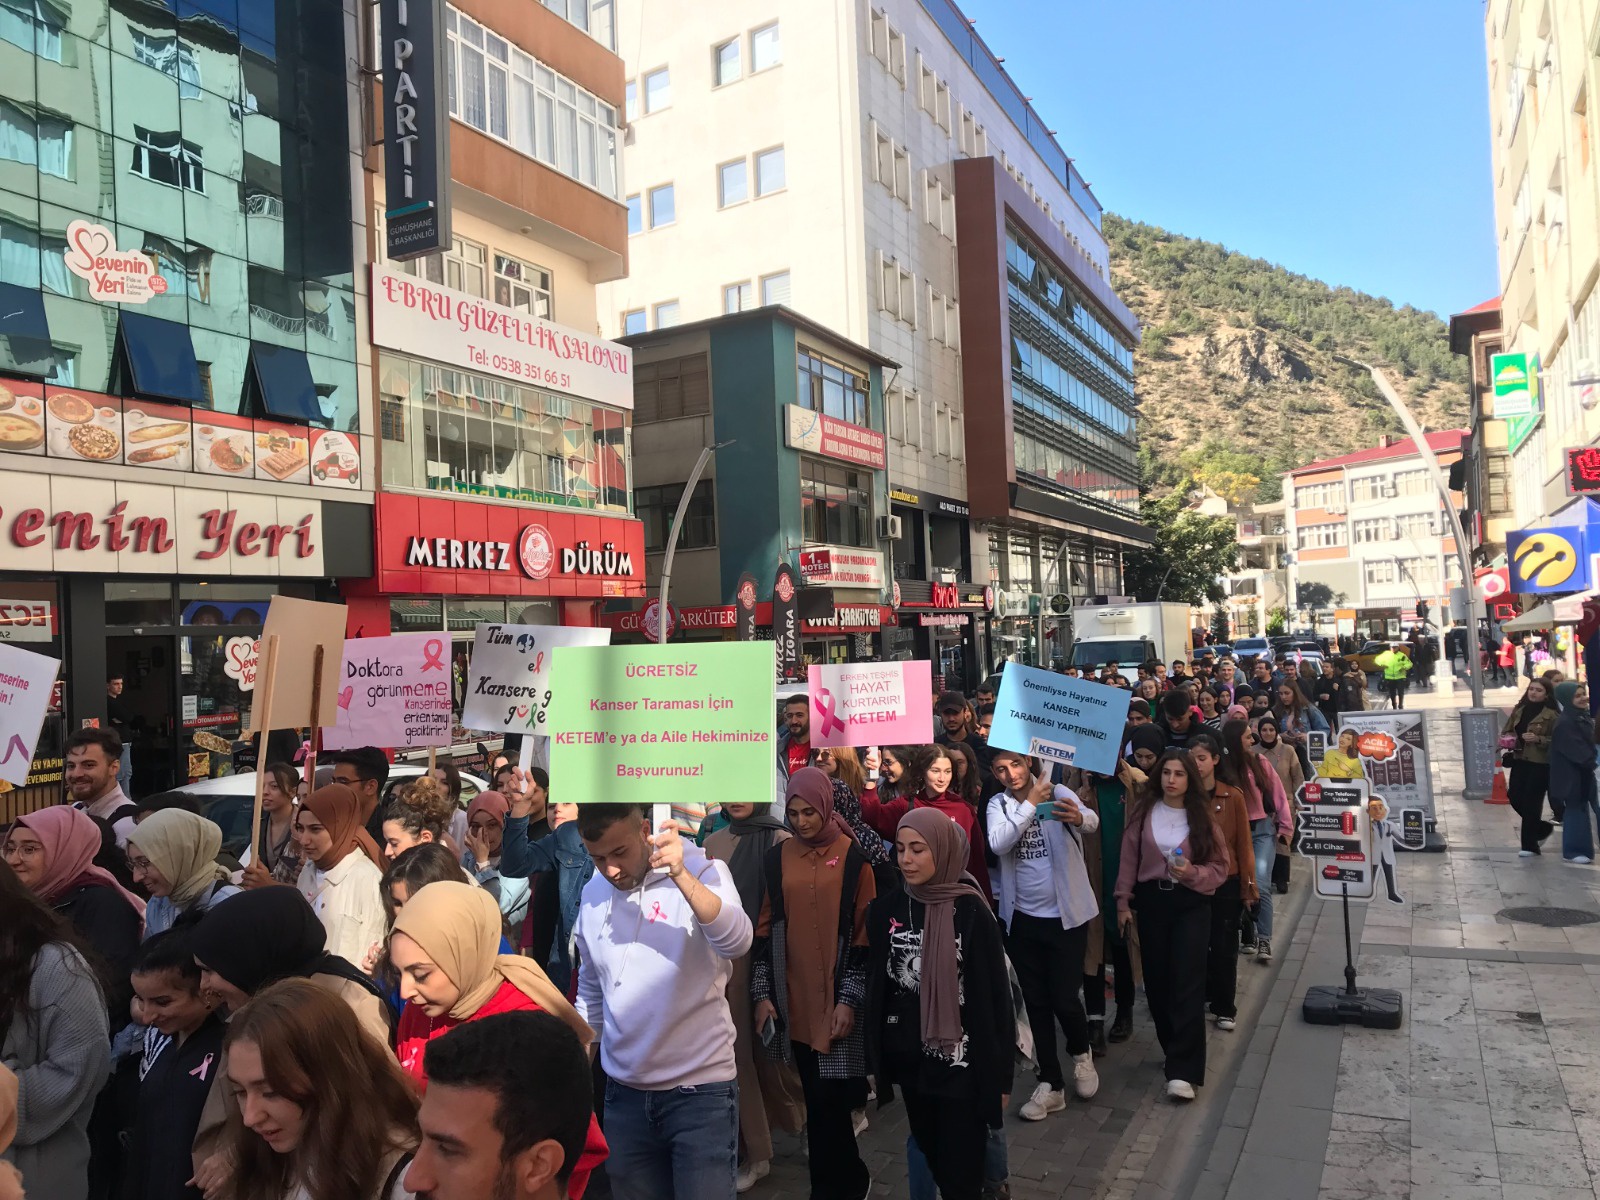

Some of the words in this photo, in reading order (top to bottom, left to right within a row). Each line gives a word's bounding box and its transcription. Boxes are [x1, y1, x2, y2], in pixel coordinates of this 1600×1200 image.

[394, 37, 418, 198] PARTİ
[390, 218, 432, 235] GÜMÜŞHANE
[395, 229, 434, 245] BAŞKANLIĞI
[74, 228, 148, 274] Sevenin
[94, 271, 124, 294] Yeri
[381, 275, 452, 321] EBRU
[456, 300, 561, 358] GÜZELLİK
[562, 335, 628, 375] SALONU
[467, 345, 489, 366] Tel:
[492, 354, 522, 375] 0538
[524, 362, 542, 380] 351
[544, 369, 558, 383] 66
[561, 374, 570, 388] 51
[0, 500, 174, 553] enin
[196, 509, 315, 560] Yeri
[409, 536, 511, 570] MERKEZ
[562, 541, 634, 576] DÜRÜM
[808, 552, 822, 564] 1.
[801, 562, 829, 572] NOTER
[840, 607, 880, 630] ŞARKÜTERİ
[486, 626, 513, 645] Tüm
[786, 609, 796, 662] IZGARA
[347, 657, 403, 678] Doktora
[626, 662, 698, 678] ÜCRETSİZ
[840, 673, 868, 682] ERKEN
[870, 670, 899, 679] TEŞHİS
[475, 676, 537, 698] Kansere
[850, 681, 891, 695] HAYAT
[1023, 678, 1068, 698] Önemliyse
[1069, 688, 1108, 708] Hayatınız
[590, 698, 638, 711] Kanser
[641, 697, 704, 710] Taraması
[708, 693, 734, 711] İçin
[1043, 701, 1081, 717] KANSER
[403, 713, 431, 724] erken
[849, 710, 897, 725] KETEM
[1010, 709, 1055, 728] TARAMASI
[1056, 721, 1107, 741] YAPTIRINIZ!
[555, 731, 617, 745] KETEM'e
[621, 734, 637, 747] ya
[640, 732, 657, 744] da
[661, 731, 687, 743] Aile
[692, 730, 769, 743] Hekiminize
[1038, 744, 1075, 760] KETEM
[616, 763, 704, 780] Başvurunuz!
[1310, 816, 1339, 824] Telefon
[1323, 843, 1345, 851] Cihaz
